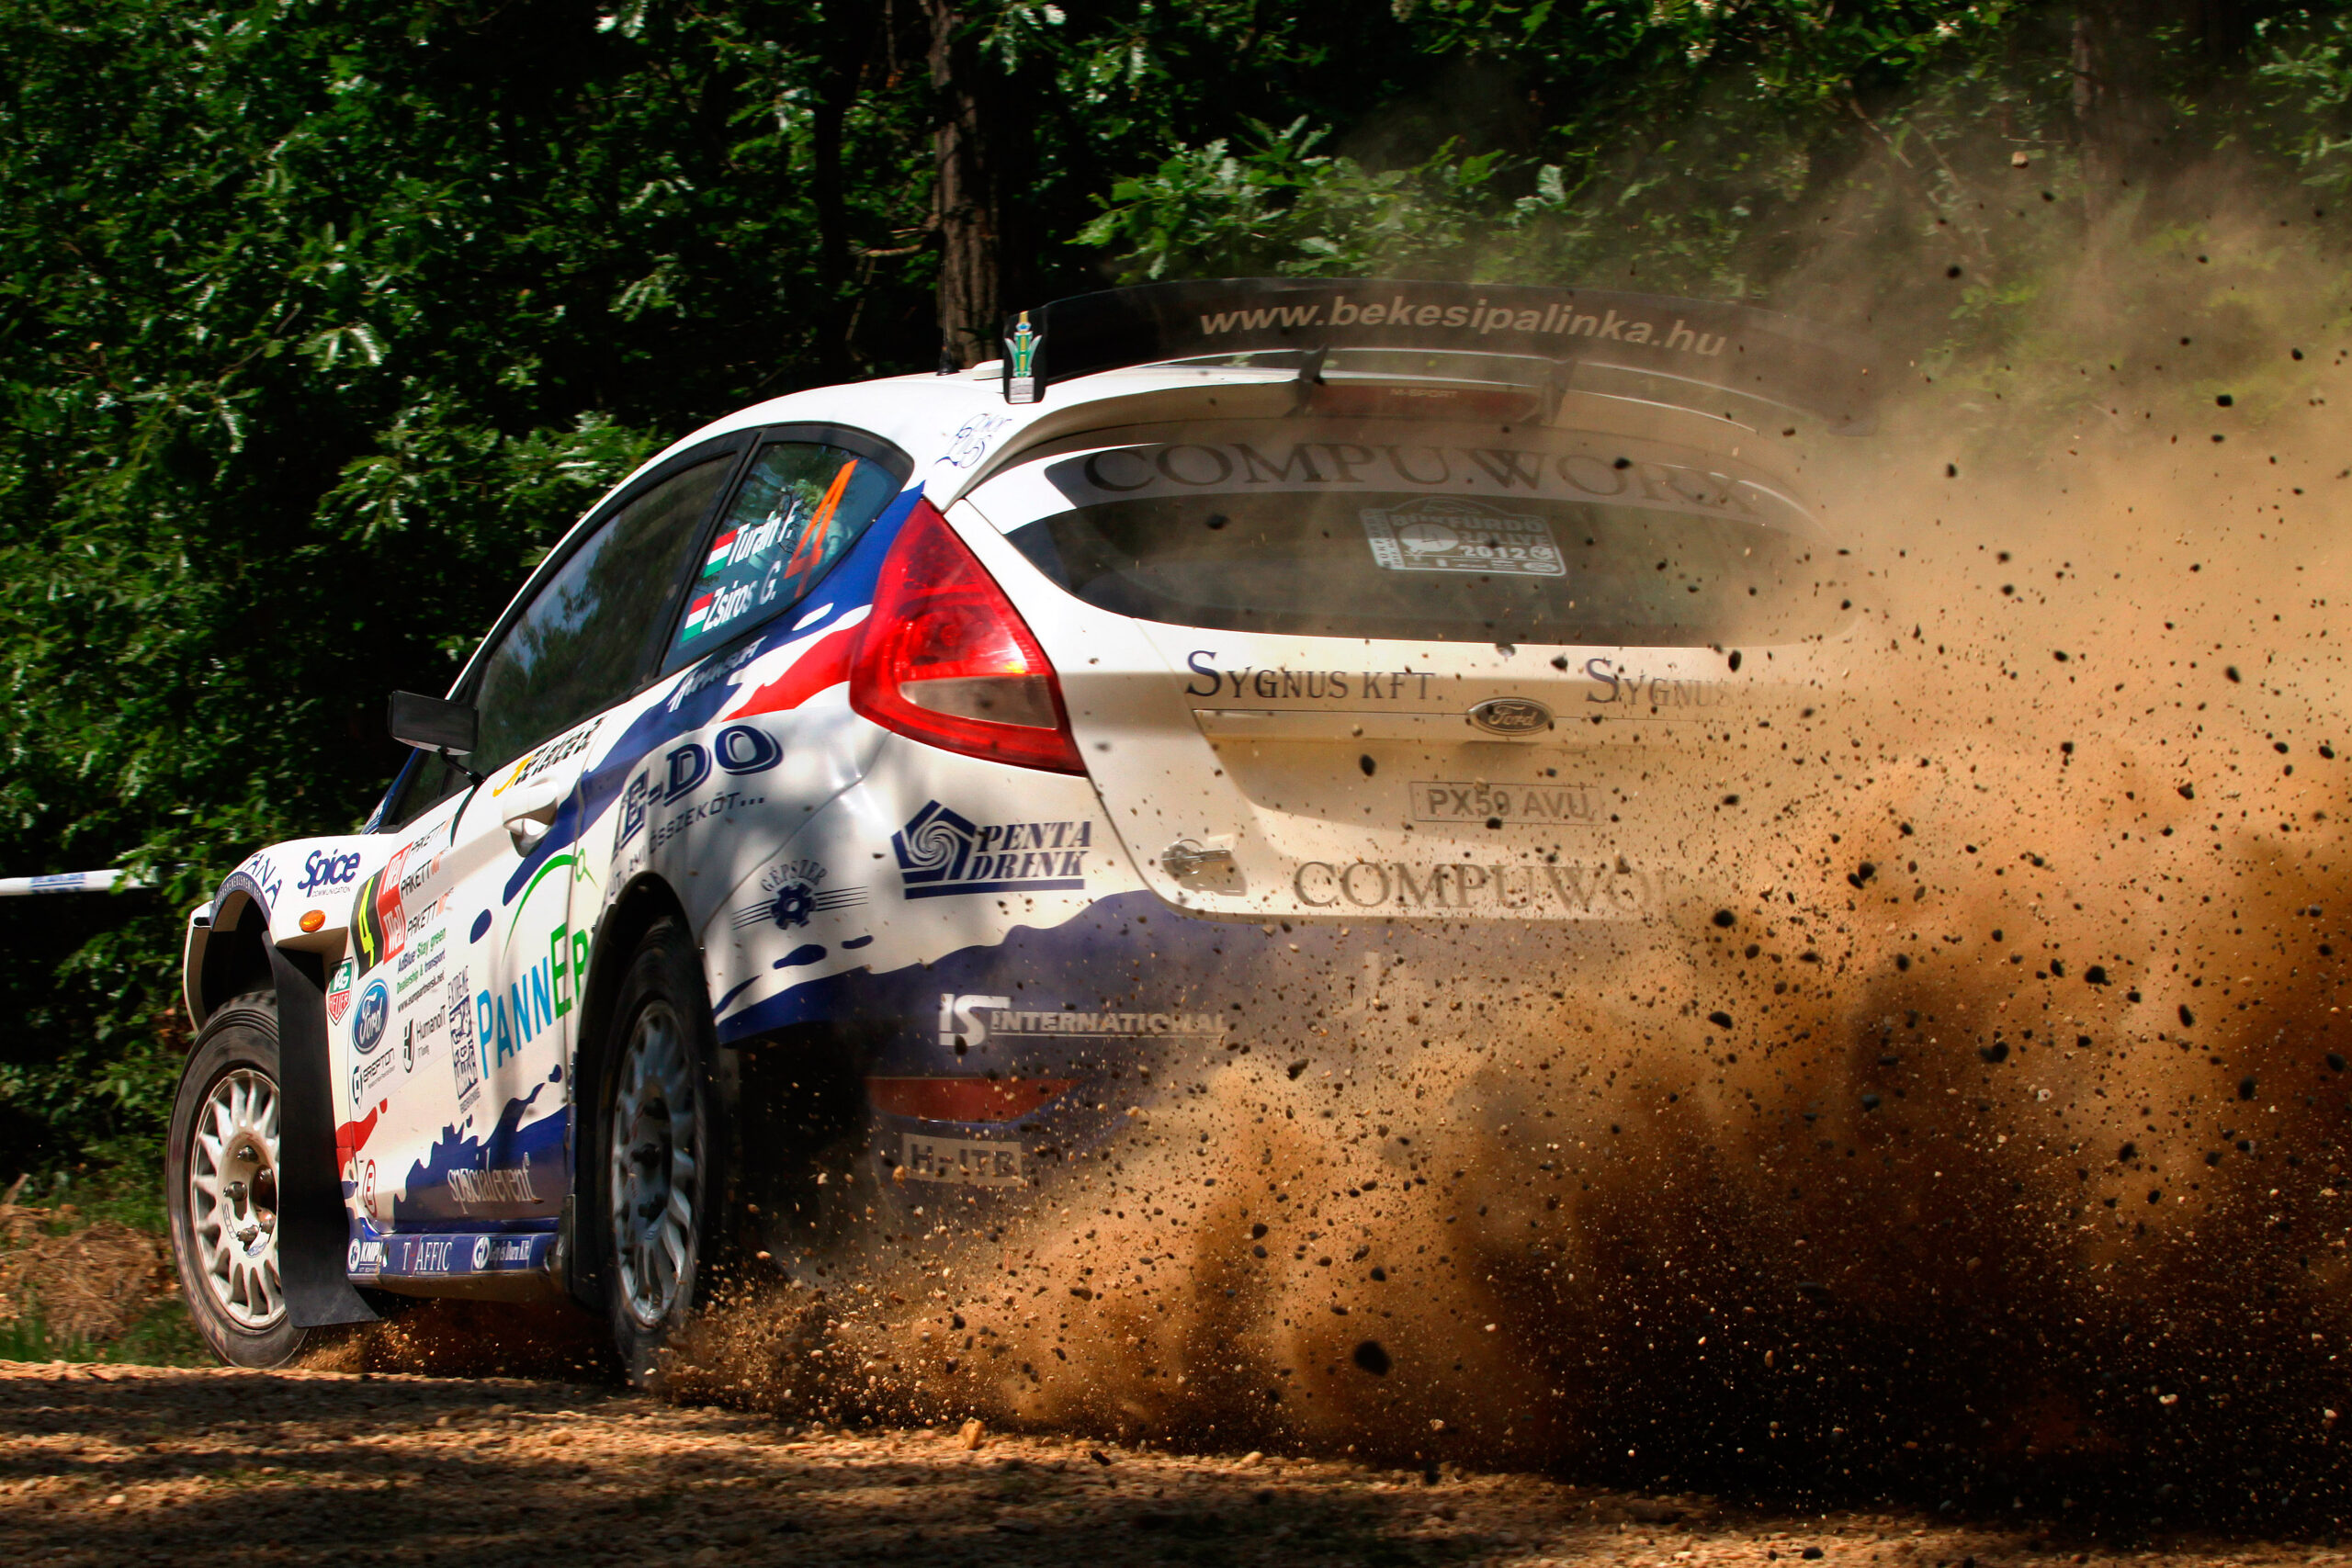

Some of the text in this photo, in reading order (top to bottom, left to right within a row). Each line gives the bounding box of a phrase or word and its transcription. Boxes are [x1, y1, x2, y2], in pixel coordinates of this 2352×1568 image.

[1200, 296, 1727, 357] www.bekesipalinka.hu
[784, 459, 858, 598] 4
[1459, 545, 1528, 559] 2012
[1185, 649, 1350, 699] SYGNUS
[1586, 657, 1734, 708] SYGNUS
[1426, 788, 1589, 818] PX59 AVU
[977, 820, 1091, 852] PENTA
[297, 848, 360, 897] Spice
[967, 851, 1091, 881] DRINK
[1293, 861, 1661, 912] COMPUWO
[334, 964, 350, 991] TAG
[329, 993, 350, 1021] HEUER
[990, 1010, 1229, 1034] INTERNATIONAL
[402, 1241, 453, 1271] TAFFIC
